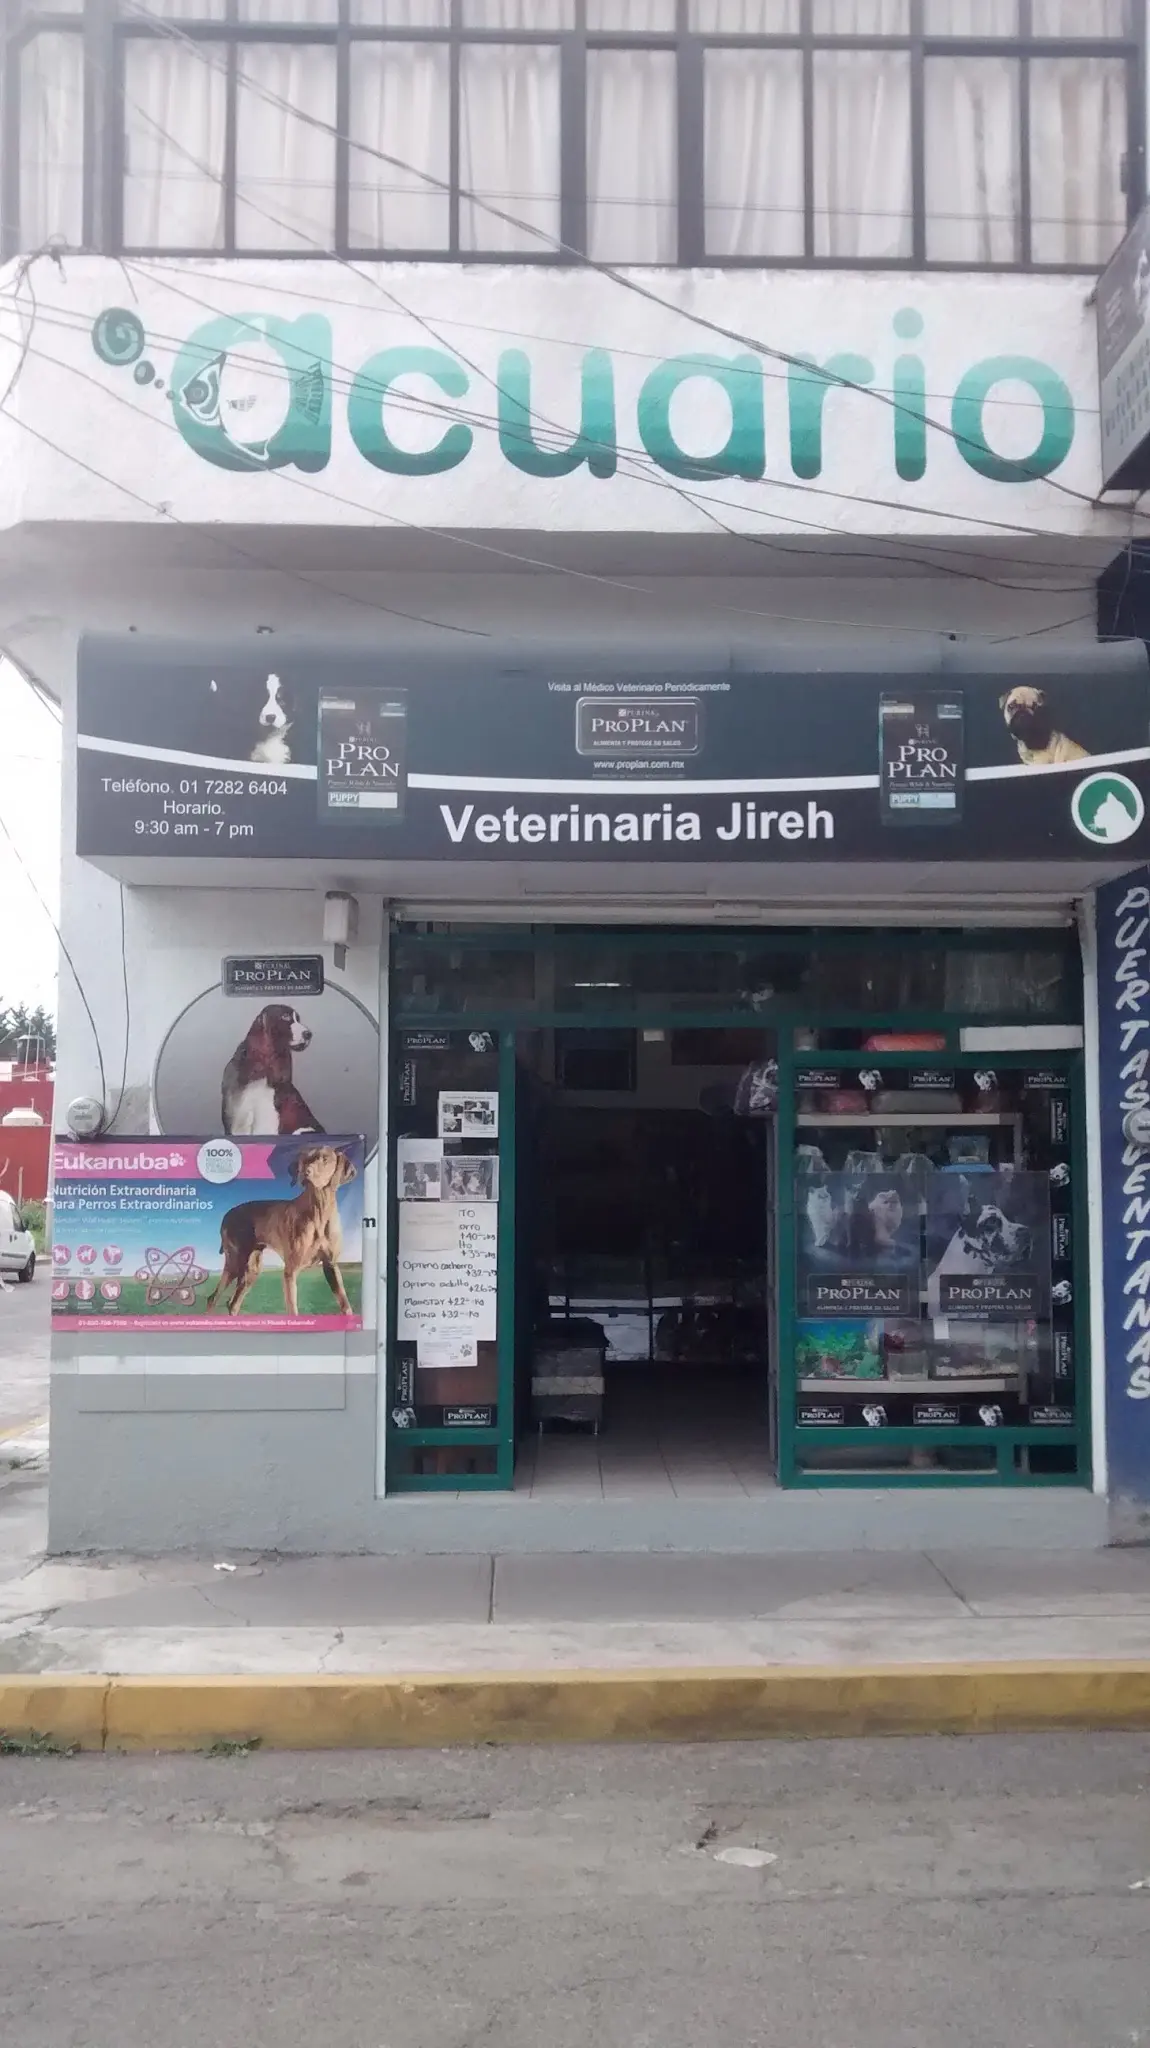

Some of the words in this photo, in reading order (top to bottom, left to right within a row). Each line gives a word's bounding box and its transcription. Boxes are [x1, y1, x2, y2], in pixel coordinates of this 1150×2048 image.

[170, 307, 1075, 483] acuario
[548, 683, 571, 692] Visita
[574, 683, 582, 692] al
[617, 683, 663, 692] Veterinario
[338, 743, 390, 760] PRO
[898, 745, 948, 762] PRO
[326, 759, 400, 777] PLAN
[594, 760, 685, 770] www.proplan.com.mx
[887, 761, 958, 778] PLAN
[180, 781, 198, 794] 01
[204, 781, 244, 795] 7282
[249, 781, 288, 796] 6404
[330, 793, 359, 802] PUPPY
[135, 820, 169, 836] 9:30
[174, 823, 199, 836] am
[215, 821, 224, 836] 7
[229, 823, 254, 838] pm
[439, 803, 701, 843] Veterinaria
[716, 801, 834, 841] Jireh
[54, 1152, 169, 1170] Eukanuba
[206, 1149, 233, 1157] 100%
[110, 1184, 196, 1196] Extraordinaria
[79, 1199, 117, 1211] Perros
[120, 1198, 213, 1211] Extraordinarios
